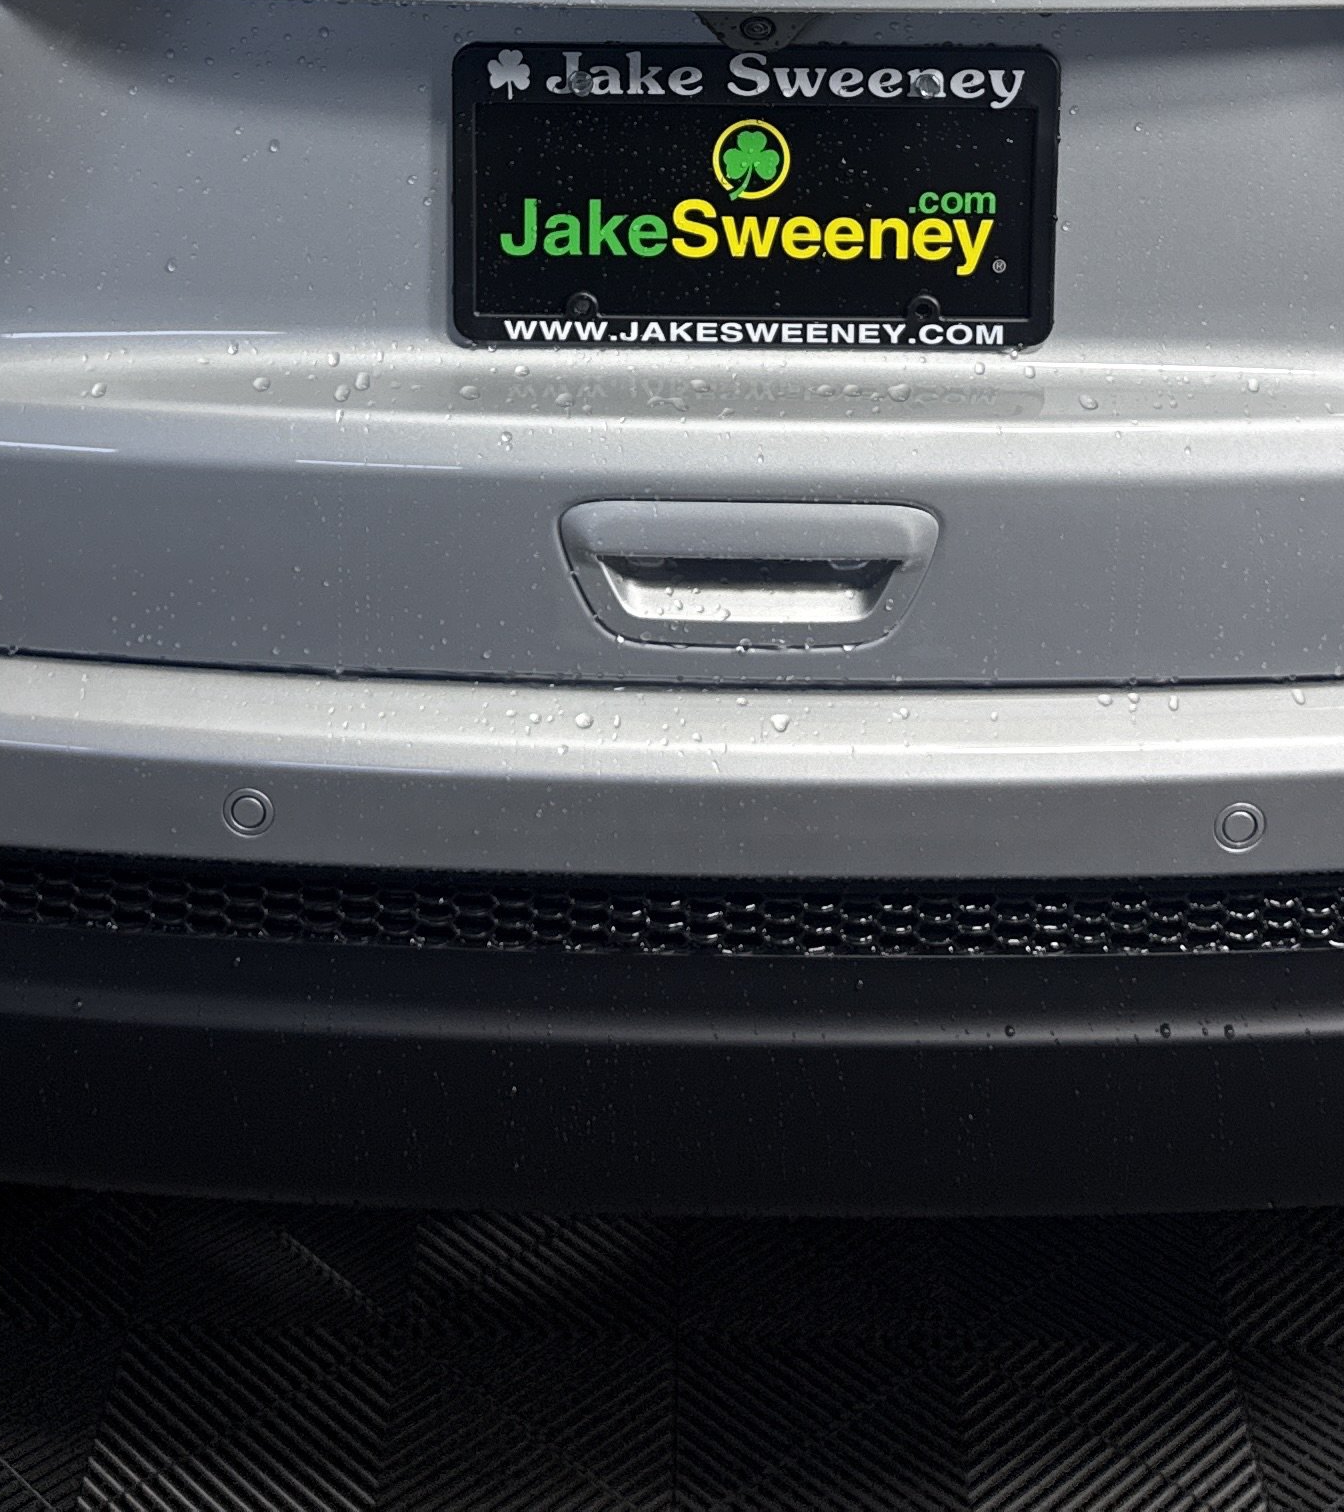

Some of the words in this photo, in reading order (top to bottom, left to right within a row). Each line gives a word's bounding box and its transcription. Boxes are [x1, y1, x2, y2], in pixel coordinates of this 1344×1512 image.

[546, 50, 704, 98] Jake
[726, 52, 1026, 109] Sweeney
[908, 191, 997, 215] .com
[500, 197, 995, 276] JakeSweeney
[503, 320, 1005, 346] WWW.JAKESWEENEY.COM
